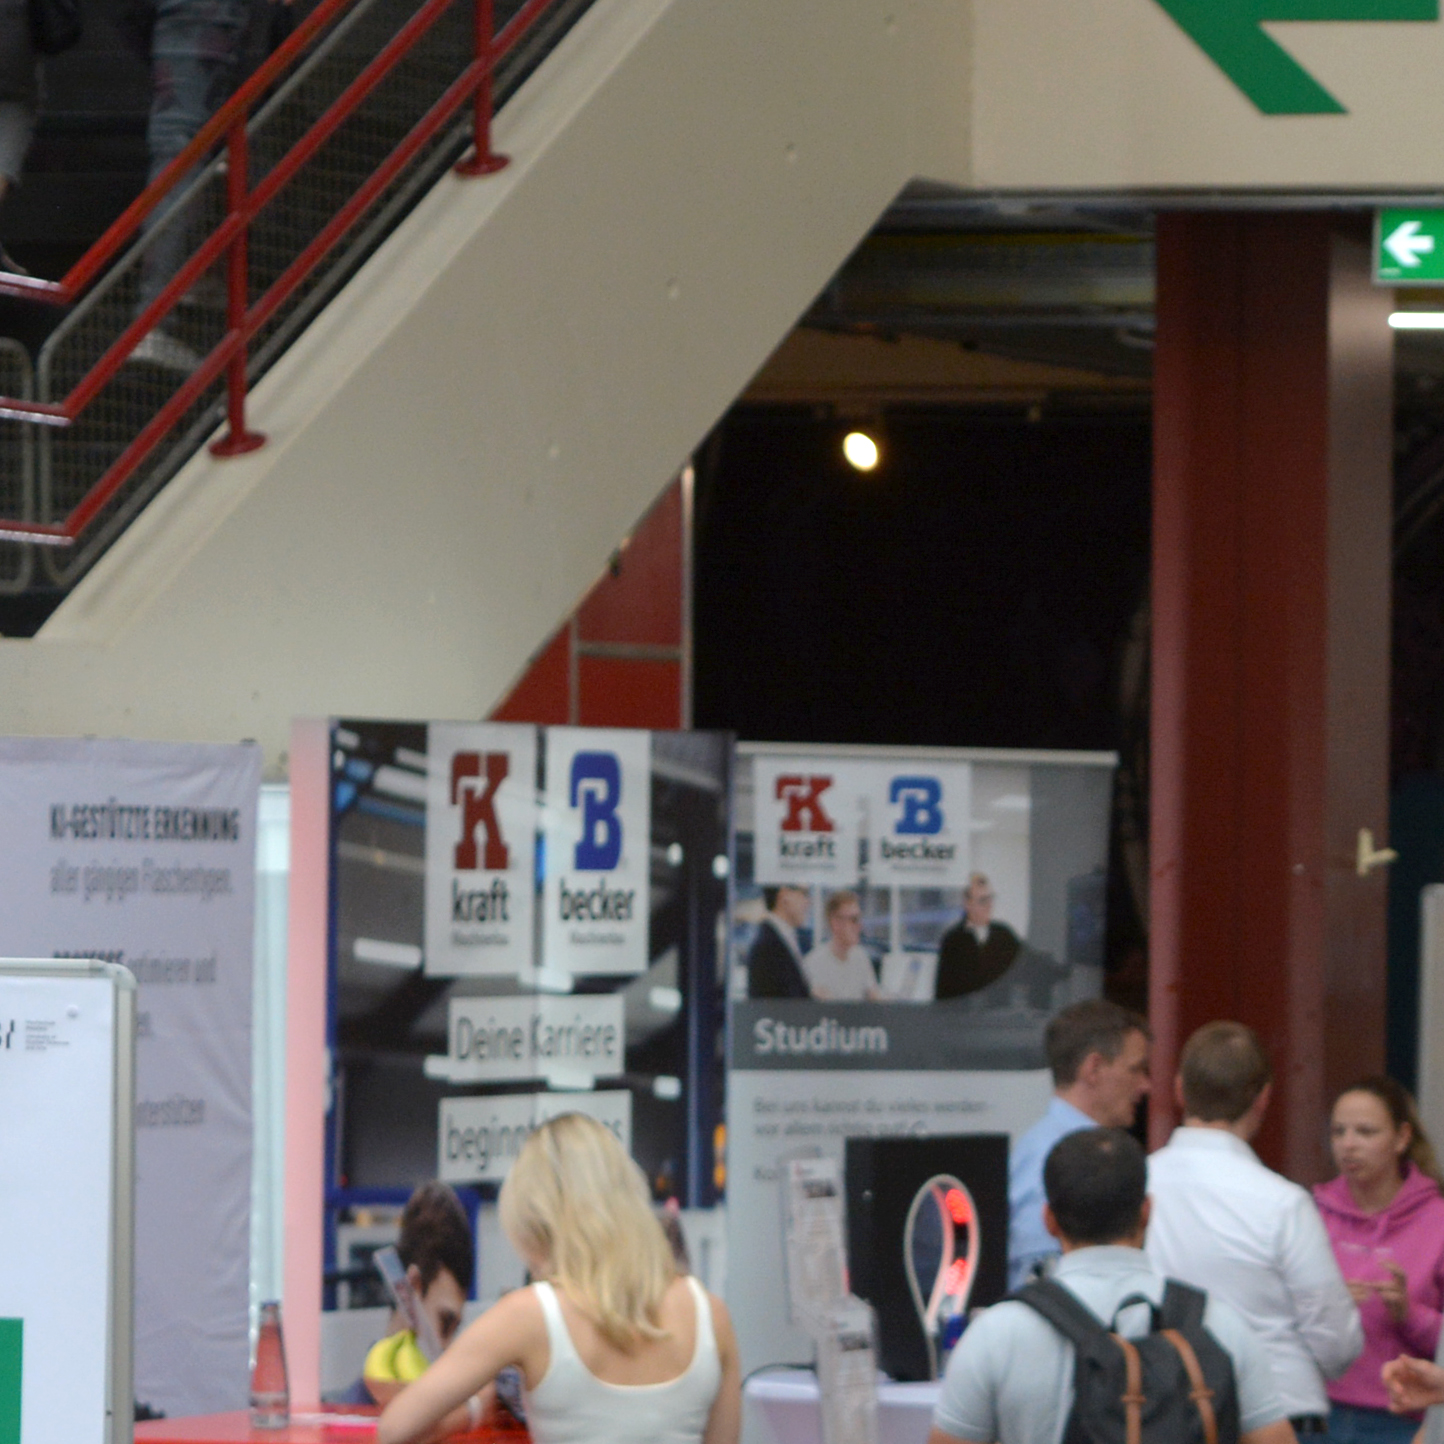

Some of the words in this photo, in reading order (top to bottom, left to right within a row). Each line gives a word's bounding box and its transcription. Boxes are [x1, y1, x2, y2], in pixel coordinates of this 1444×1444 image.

[778, 836, 836, 859] kraft
[880, 836, 956, 862] becker
[452, 876, 510, 923] kraft
[560, 876, 635, 922] becker
[456, 1015, 524, 1061] Deine
[530, 1012, 617, 1057] Karriere
[753, 1017, 889, 1054] Studium
